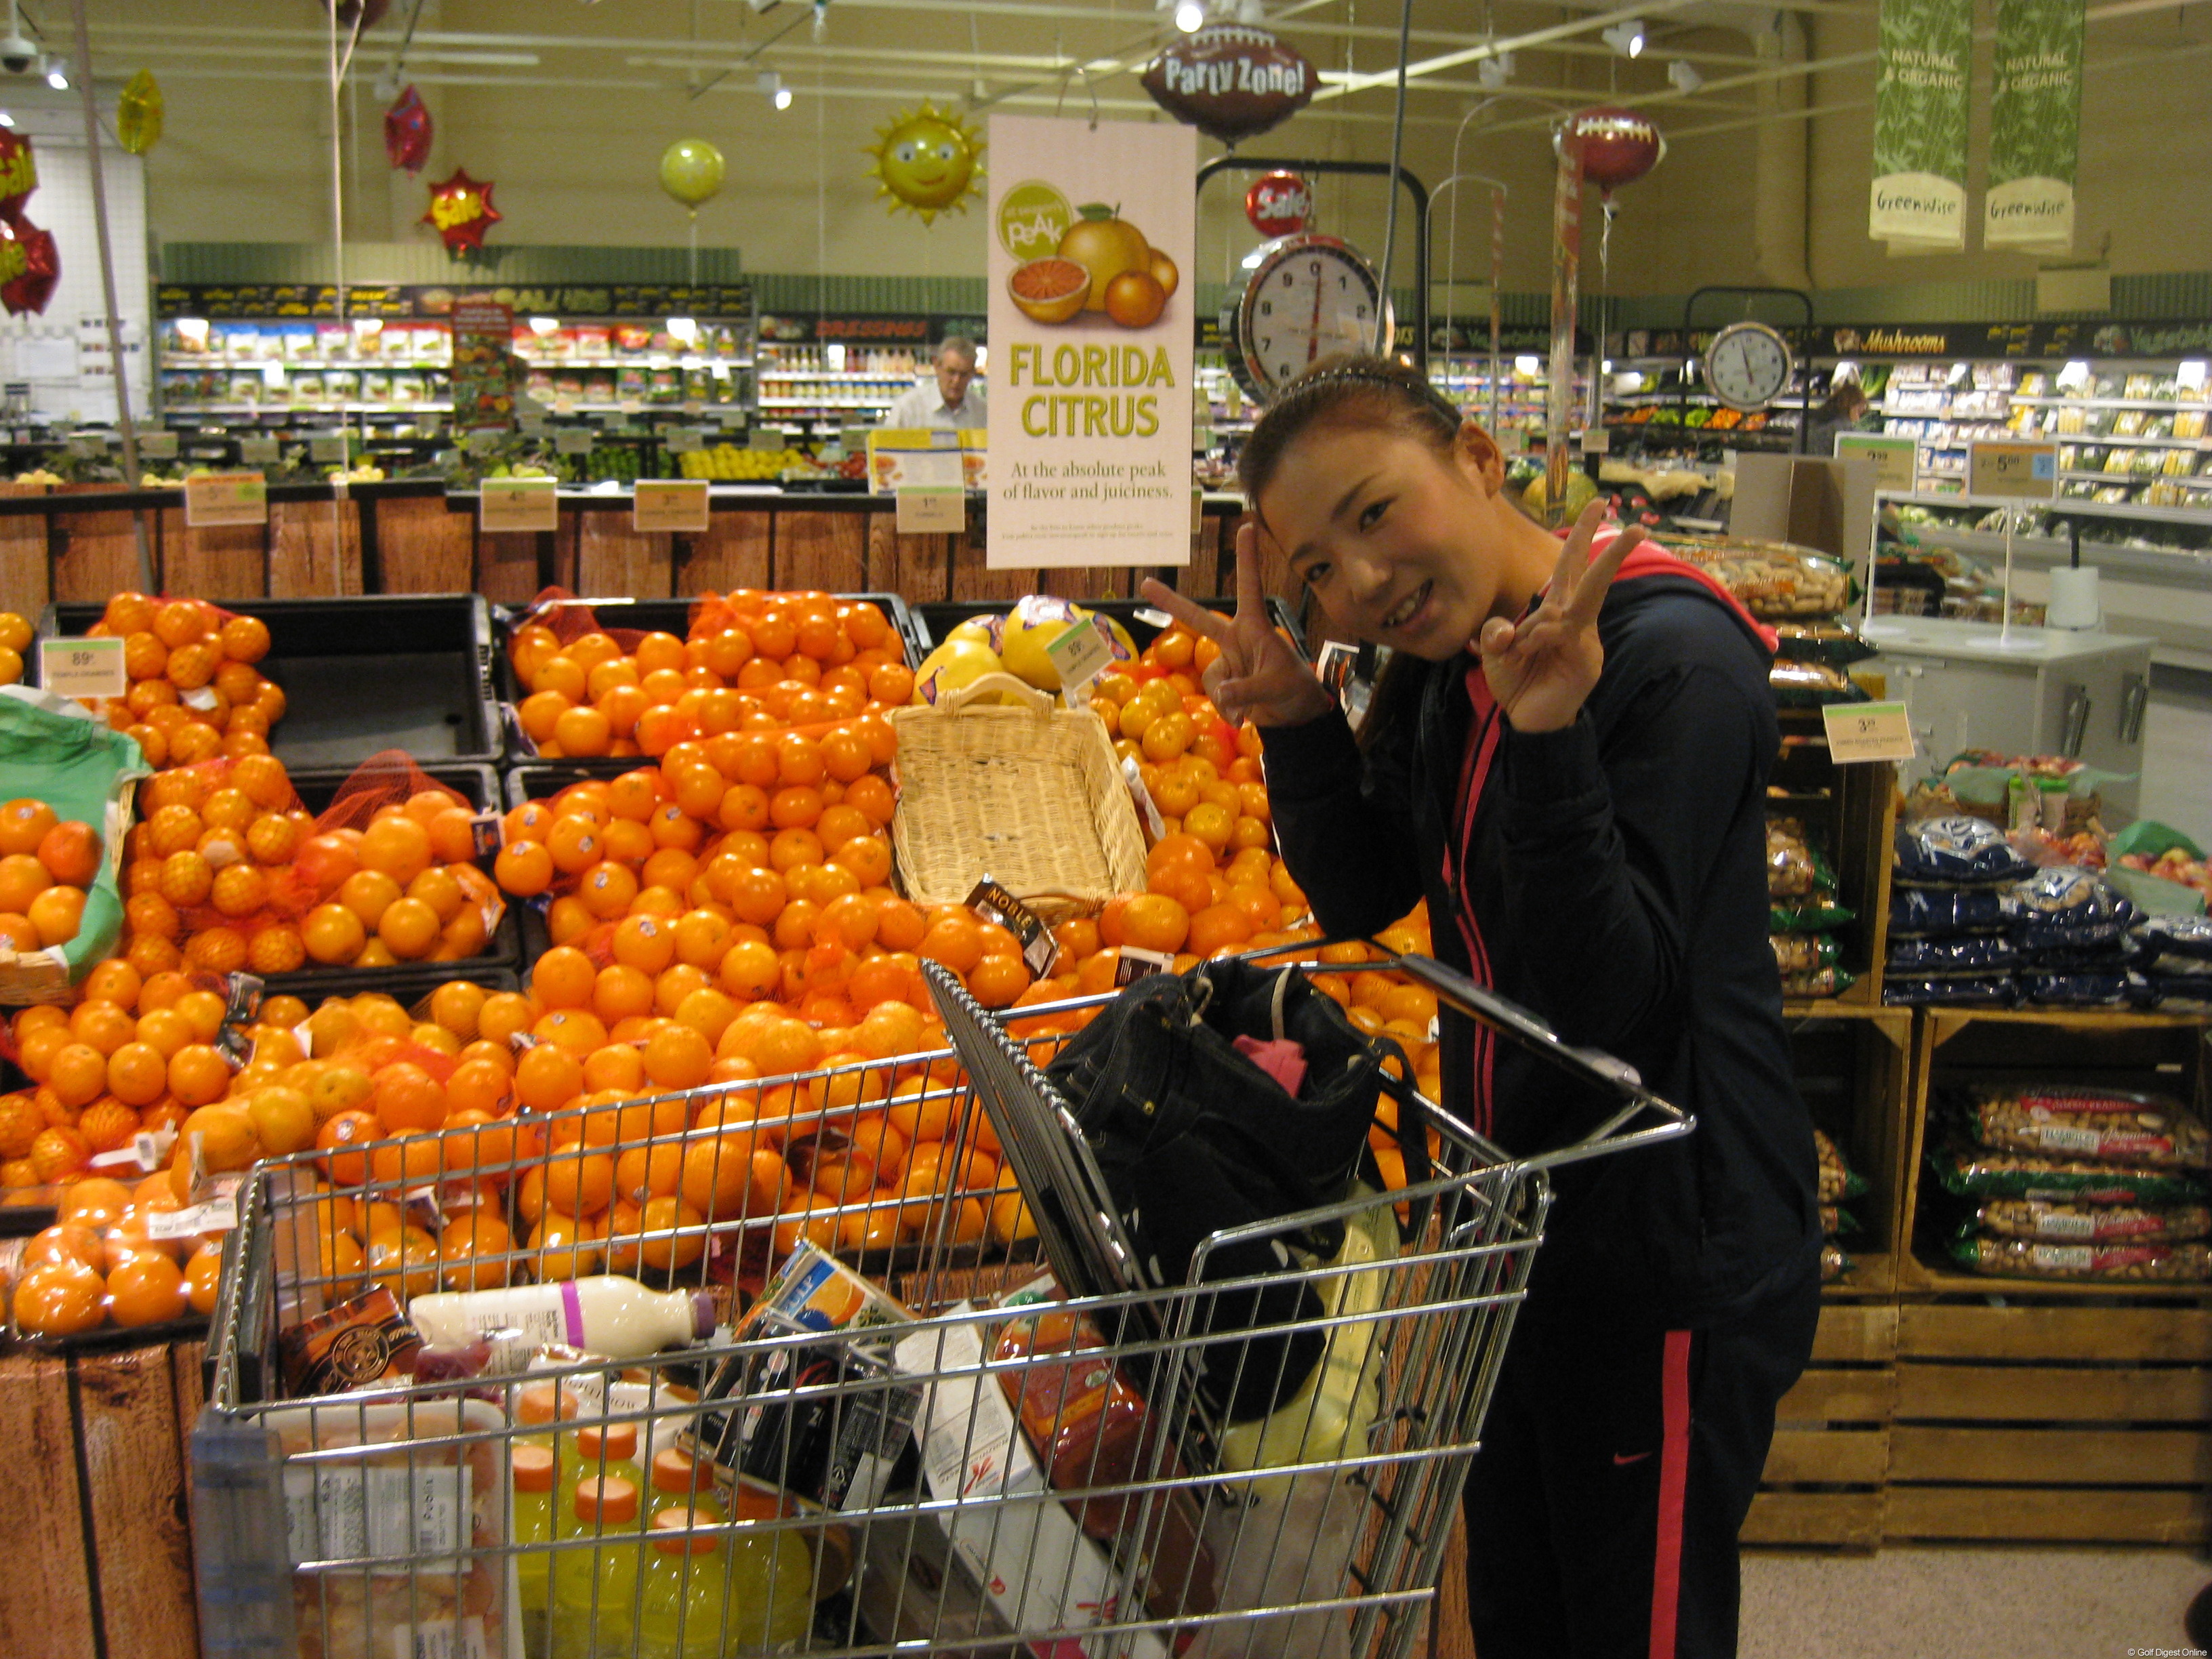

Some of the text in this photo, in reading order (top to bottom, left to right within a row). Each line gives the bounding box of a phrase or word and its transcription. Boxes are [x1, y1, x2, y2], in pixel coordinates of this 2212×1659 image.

[1892, 49, 1957, 71] NATURAL
[2006, 52, 2067, 73] NATURAL
[1165, 56, 1305, 98] Party Zone!
[1899, 68, 1963, 89] ORGANIC
[2011, 71, 2072, 90] ORGANIC
[1861, 328, 1946, 353] Mushrooms
[1010, 343, 1175, 388] FLORIDA
[1021, 394, 1160, 438] CITRUS
[1011, 460, 1166, 481] At the absolute peak
[1003, 483, 1173, 502] of flavor and juiciness.
